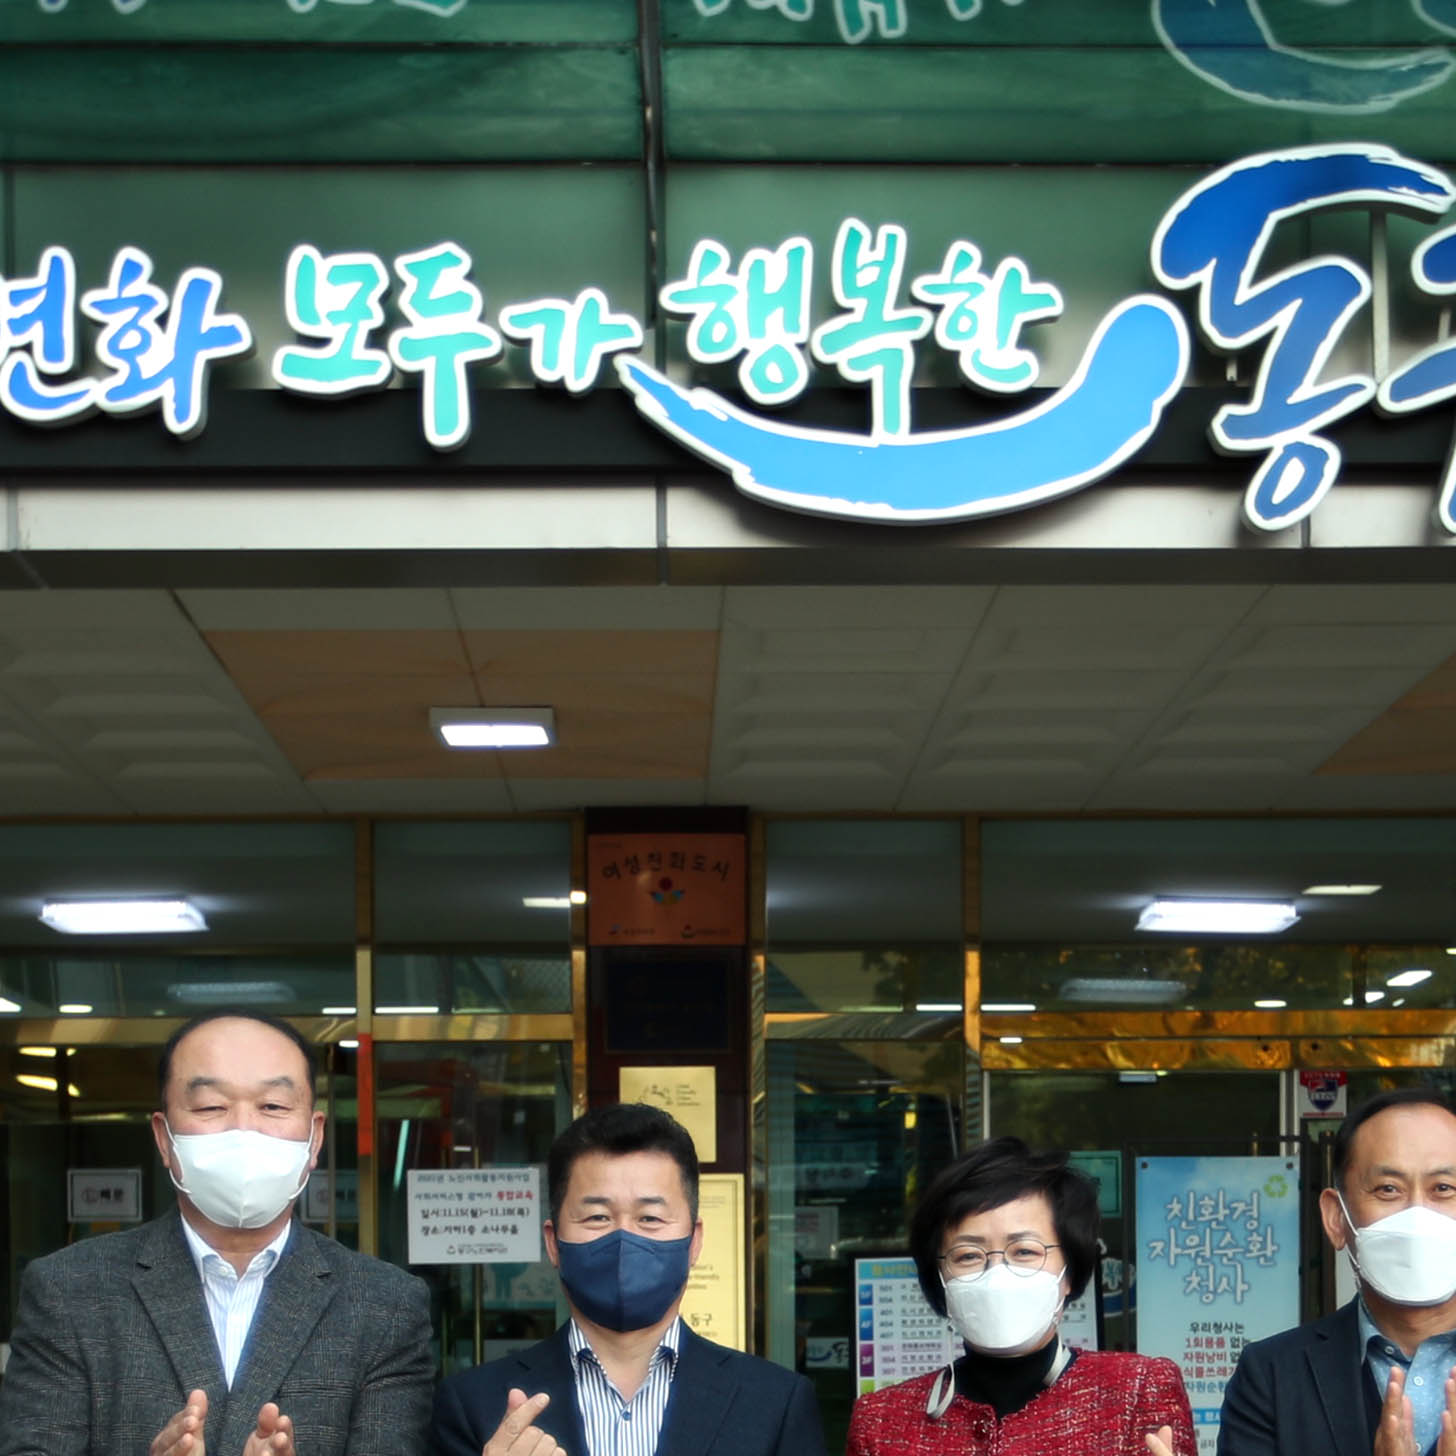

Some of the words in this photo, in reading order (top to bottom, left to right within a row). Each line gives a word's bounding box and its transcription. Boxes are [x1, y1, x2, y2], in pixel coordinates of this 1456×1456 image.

[269, 241, 644, 450] 모두가
[659, 218, 1065, 443] 행복한
[1165, 1189, 1261, 1231] 친환경
[1147, 1225, 1279, 1267] 자원순환
[1184, 1261, 1250, 1305] 청사
[1189, 1321, 1245, 1335] 우리청사는
